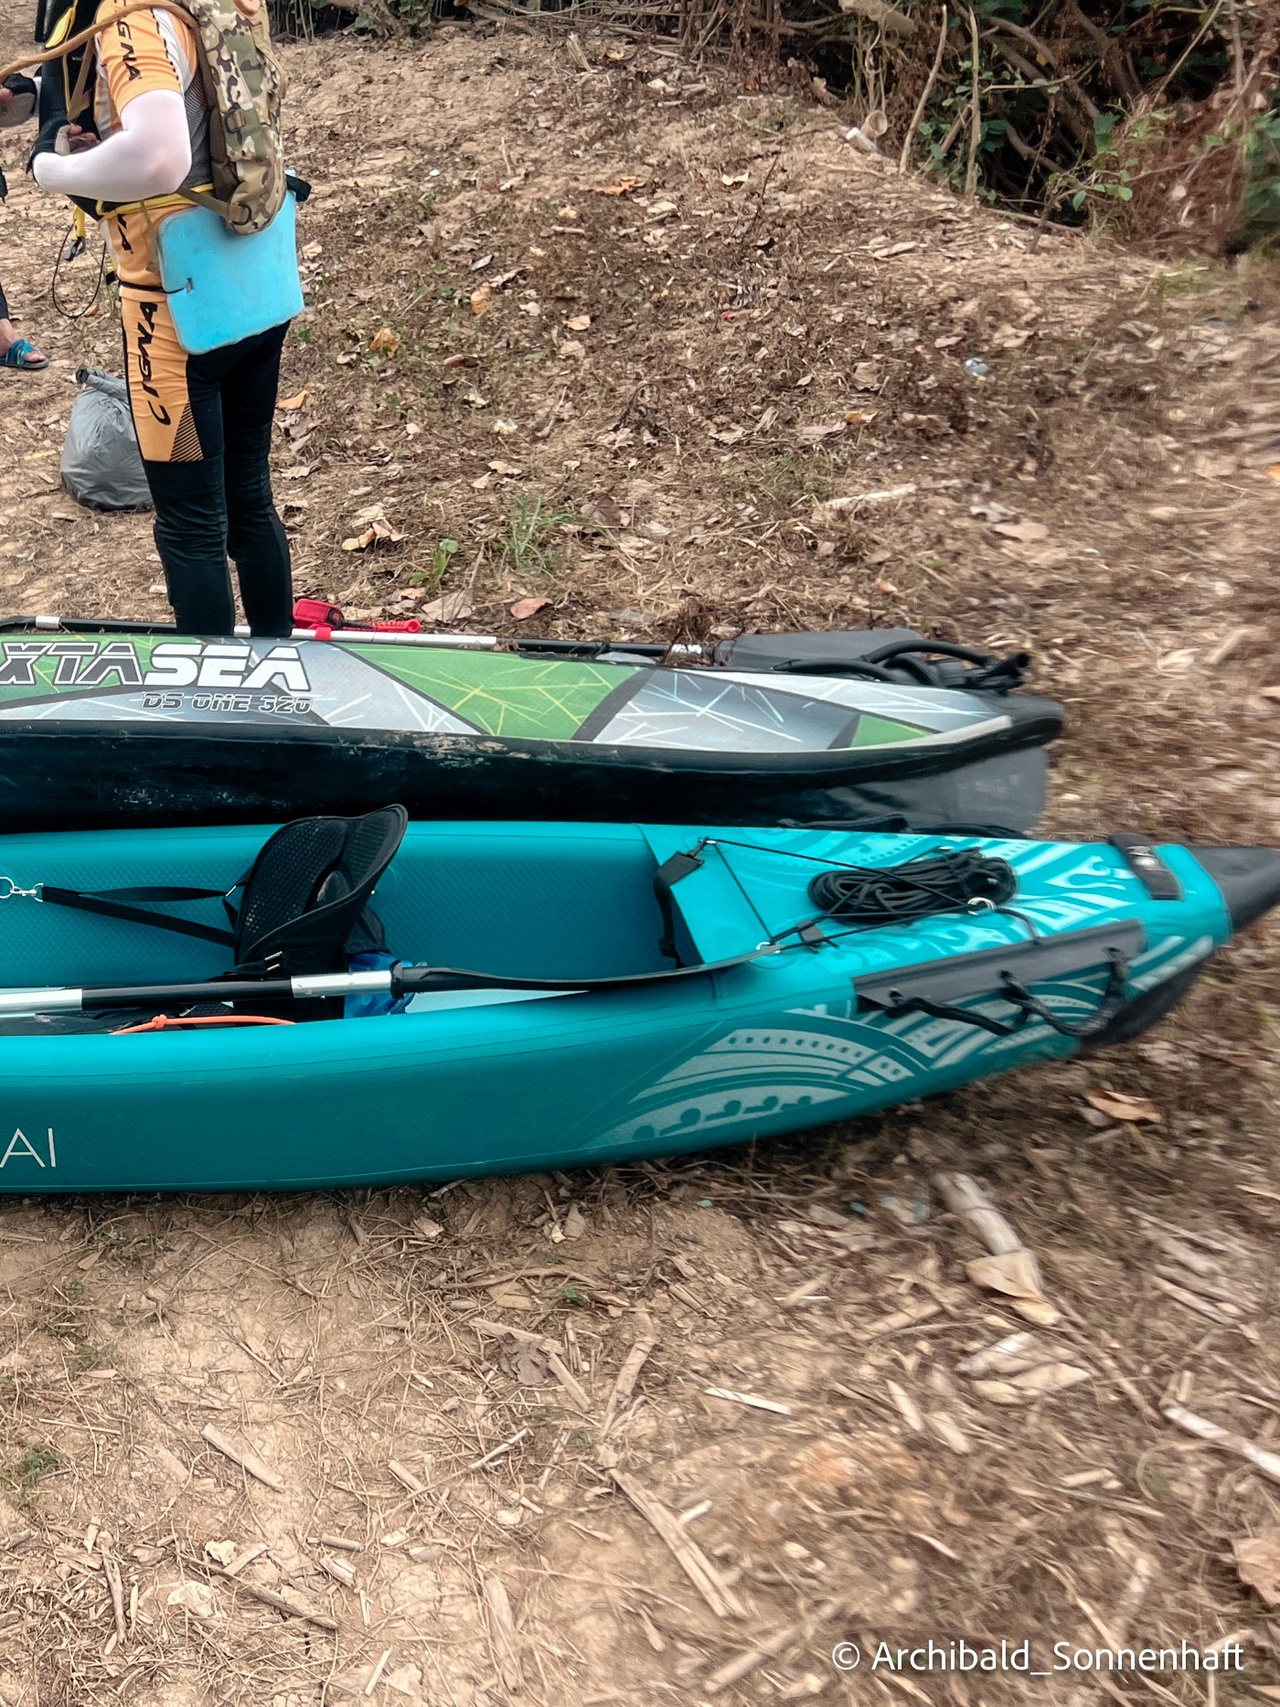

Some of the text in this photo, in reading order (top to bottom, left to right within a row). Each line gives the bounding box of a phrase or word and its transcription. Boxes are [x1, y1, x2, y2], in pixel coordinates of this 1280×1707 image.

[114, 0, 141, 81] GNA
[137, 301, 171, 426] CIGNA
[142, 691, 312, 714] DS ONE 320
